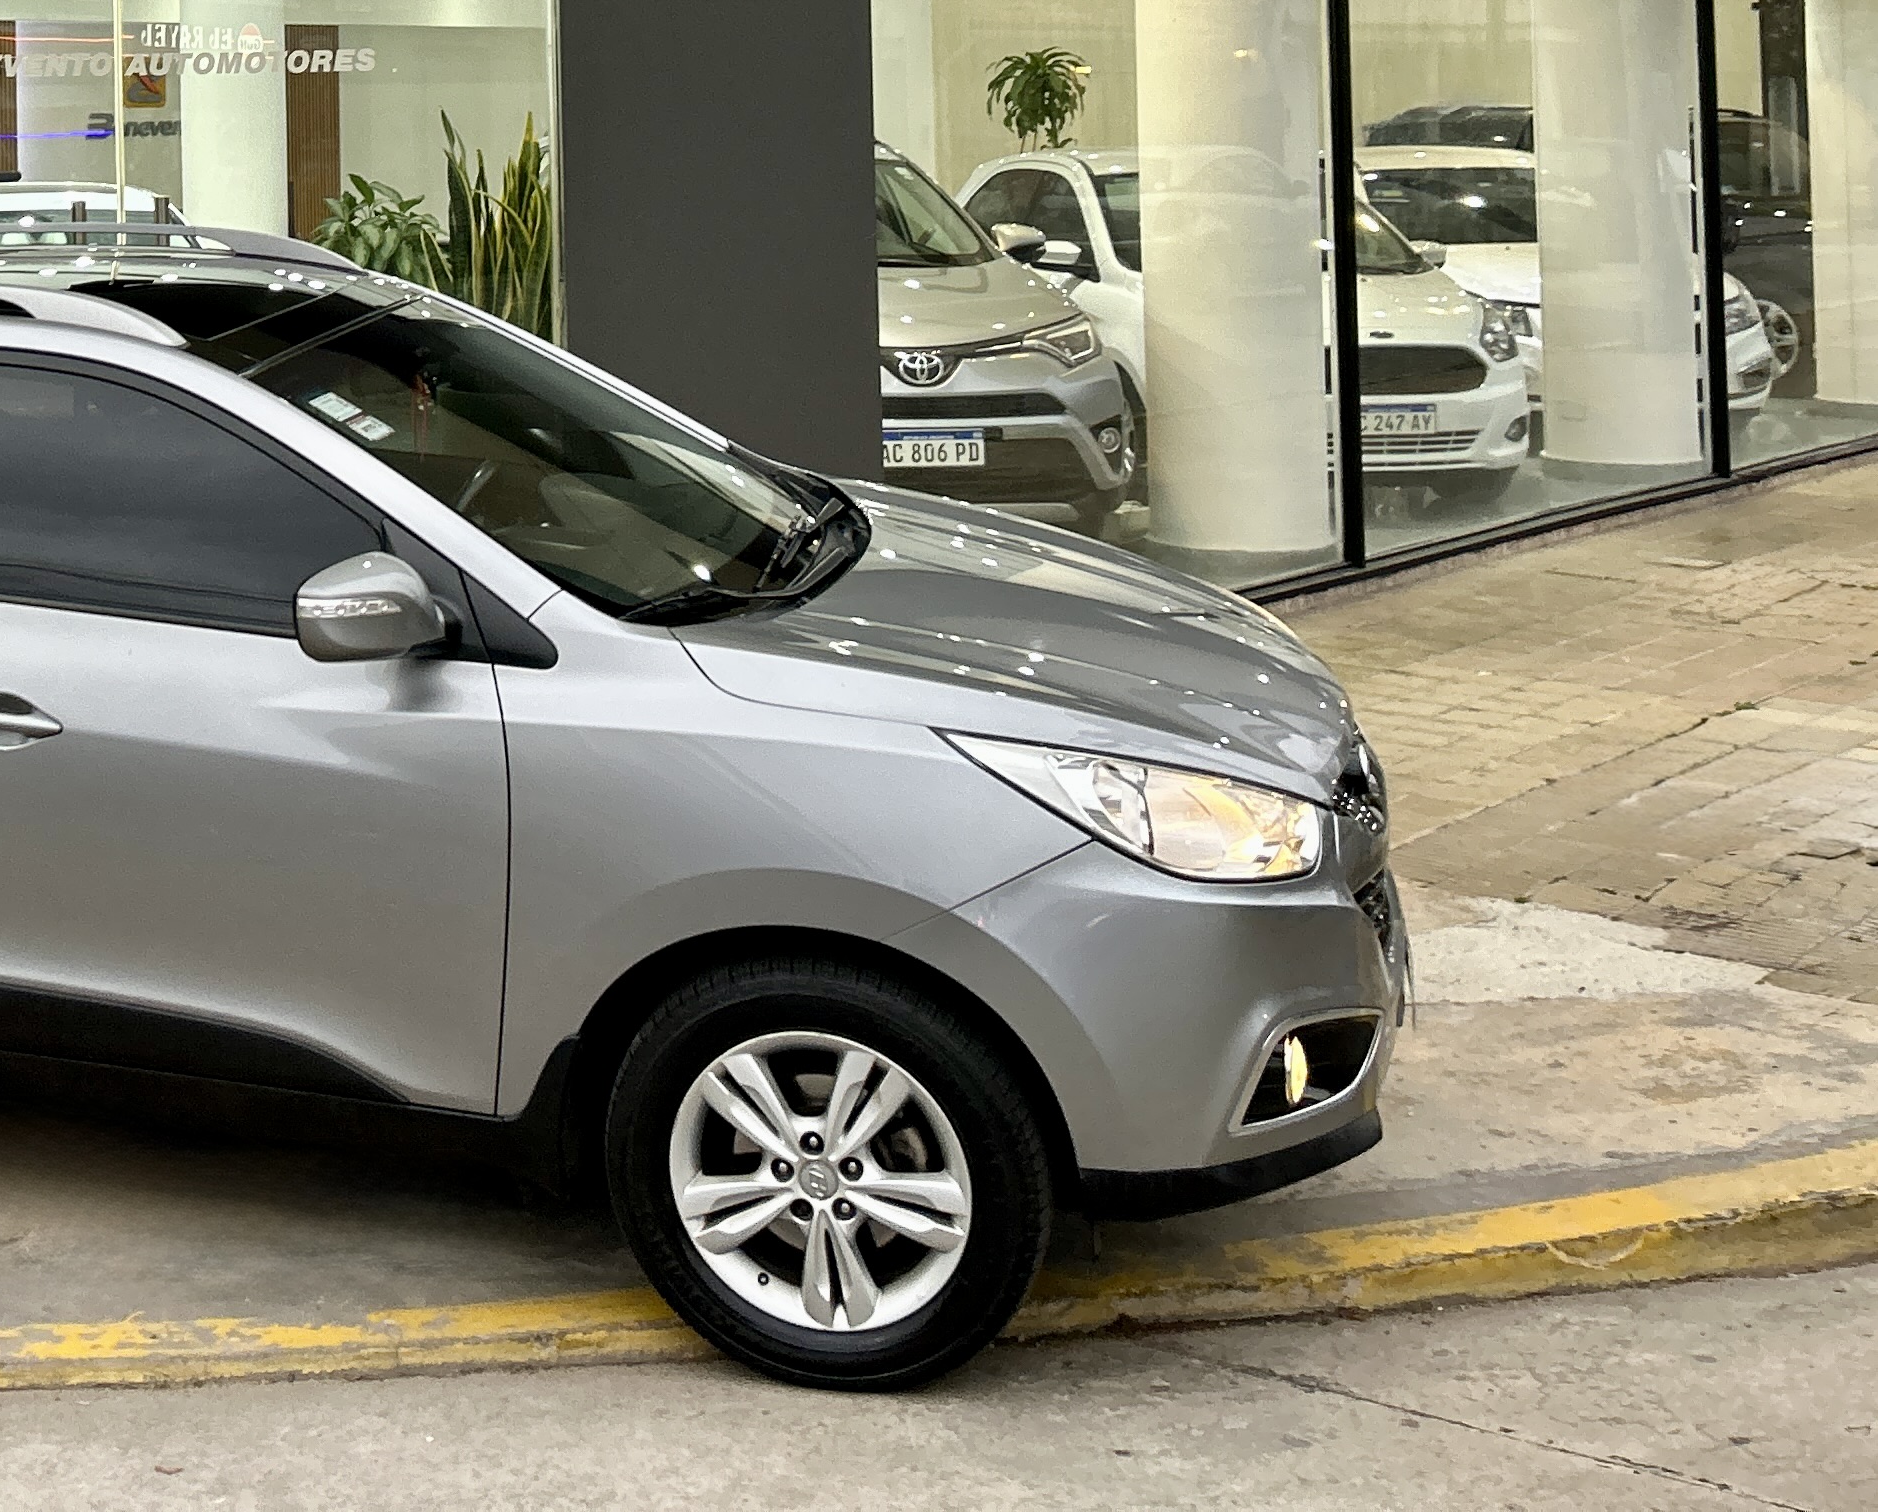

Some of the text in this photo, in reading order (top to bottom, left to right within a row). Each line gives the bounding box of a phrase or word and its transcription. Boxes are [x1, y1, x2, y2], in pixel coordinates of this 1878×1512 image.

[124, 48, 376, 77] AUTOMOTORES
[1373, 414, 1404, 432] 247
[1410, 413, 1432, 431] AY
[882, 442, 980, 463] AC 806 PD
